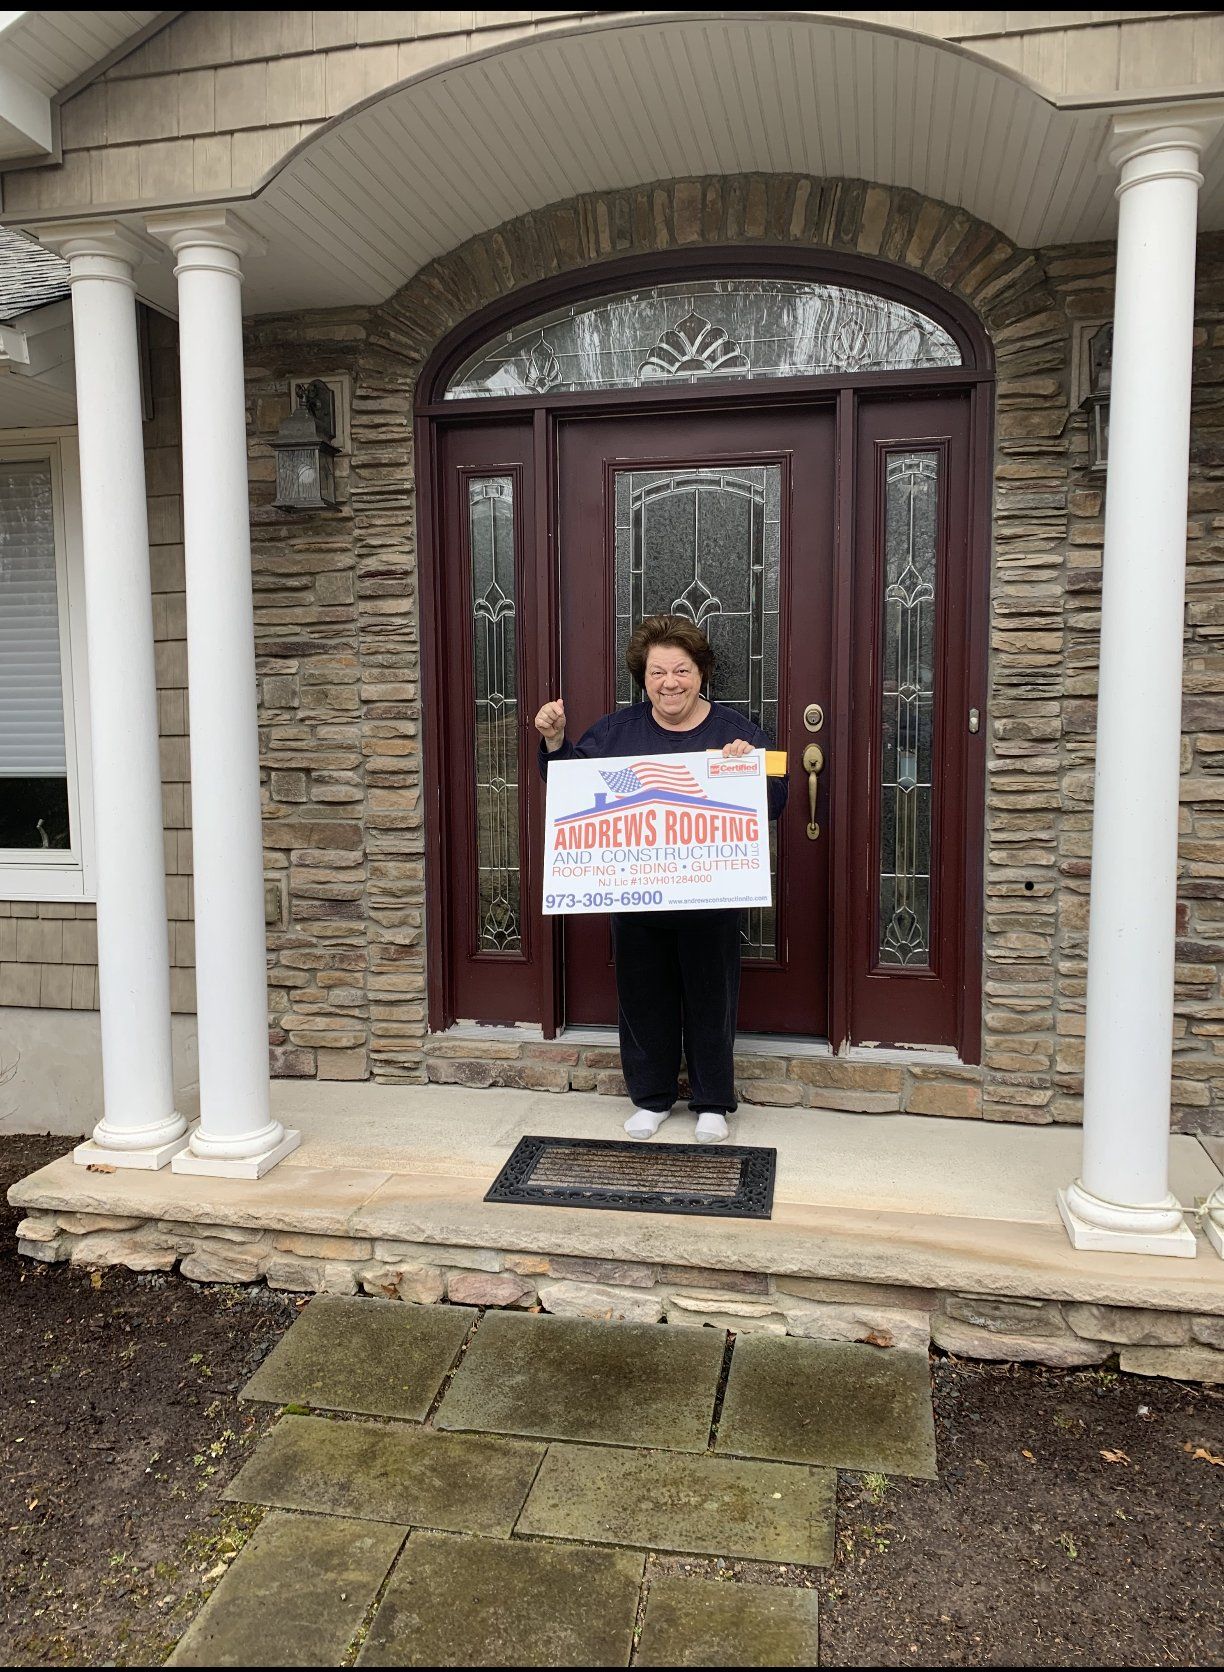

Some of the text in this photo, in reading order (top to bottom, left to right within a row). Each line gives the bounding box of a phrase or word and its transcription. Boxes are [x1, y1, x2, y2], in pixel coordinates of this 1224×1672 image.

[720, 763, 758, 772] Certified
[554, 809, 759, 850] ANDREWS ROOFING
[553, 843, 748, 866] AND CONSTRUCTION
[552, 858, 760, 878] ROOFING SIDING GUTTERS
[598, 878, 611, 887] NJ
[545, 890, 663, 909] 973-305-6900
